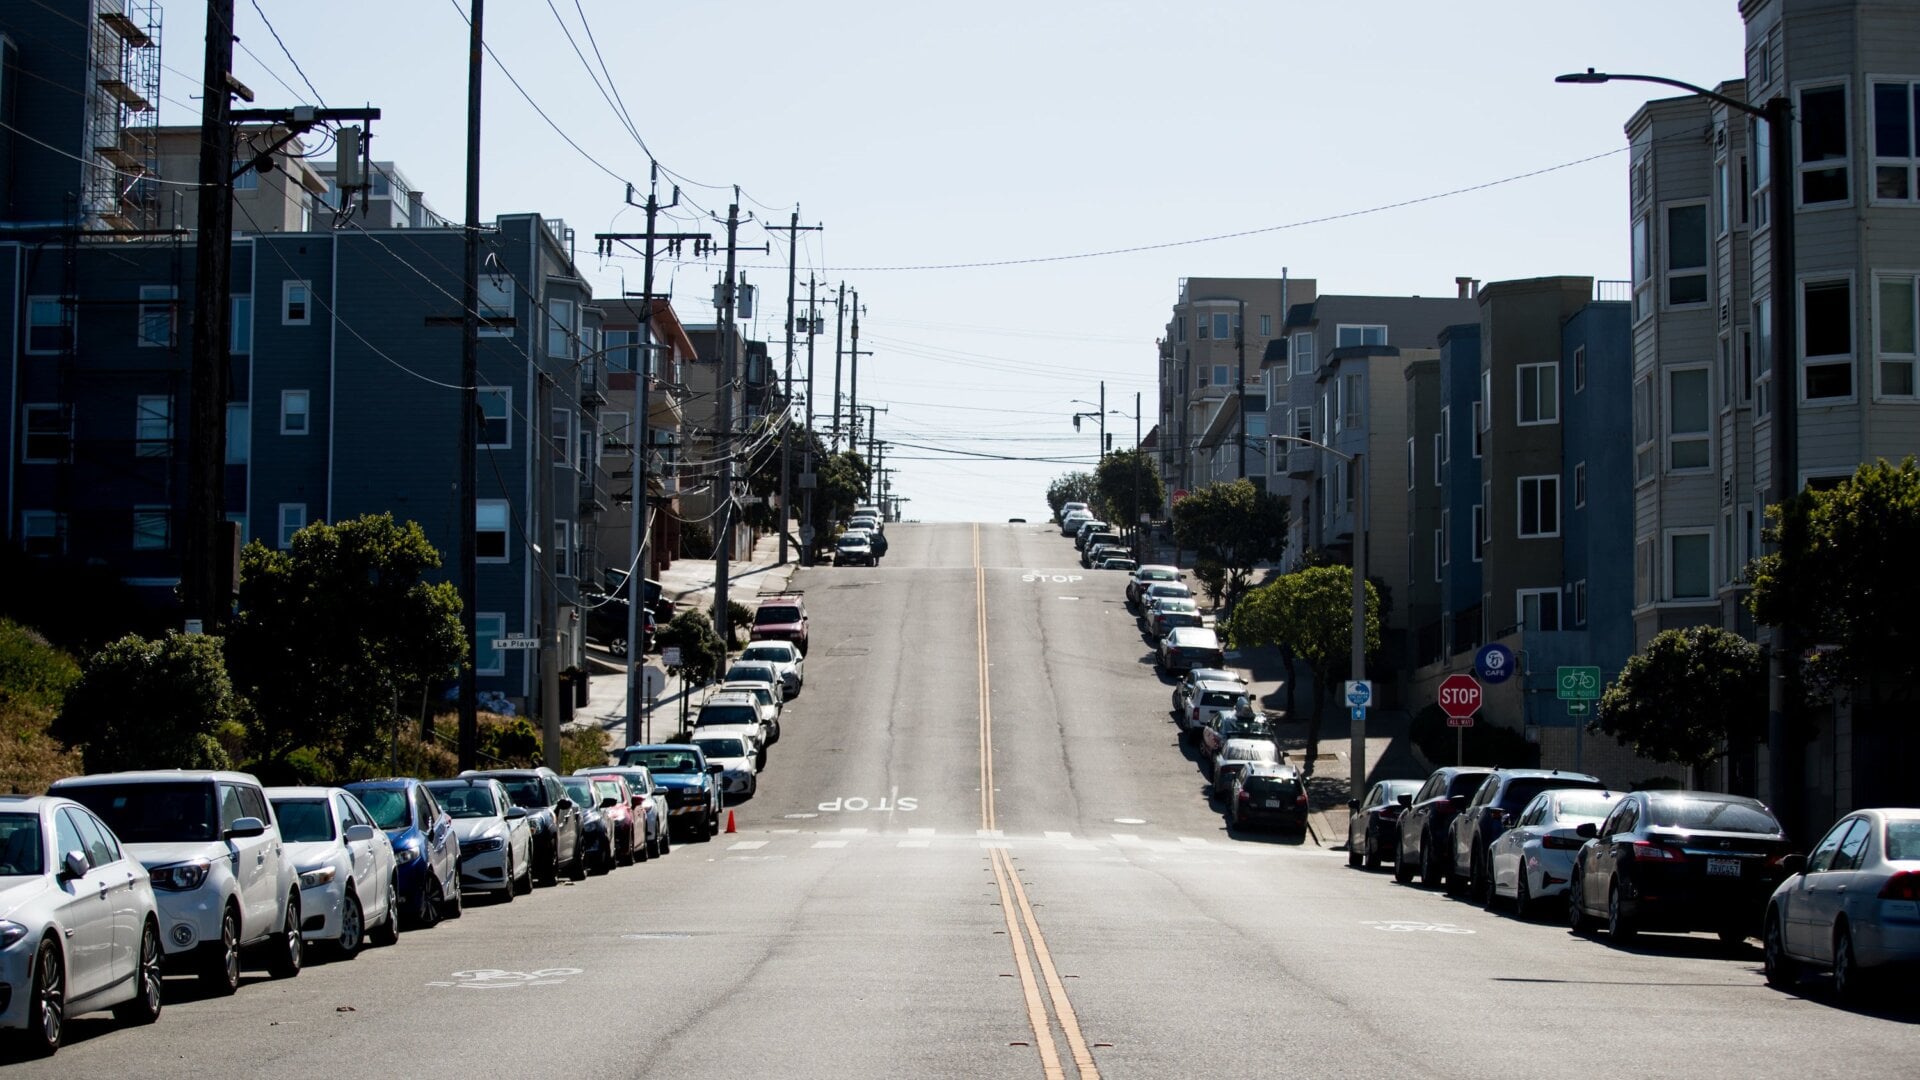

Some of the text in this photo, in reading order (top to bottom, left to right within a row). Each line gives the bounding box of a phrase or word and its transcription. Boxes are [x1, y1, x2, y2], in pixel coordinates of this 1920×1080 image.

[1022, 574, 1082, 582] STOP
[1442, 688, 1478, 704] STOP
[818, 797, 918, 811] STOP
